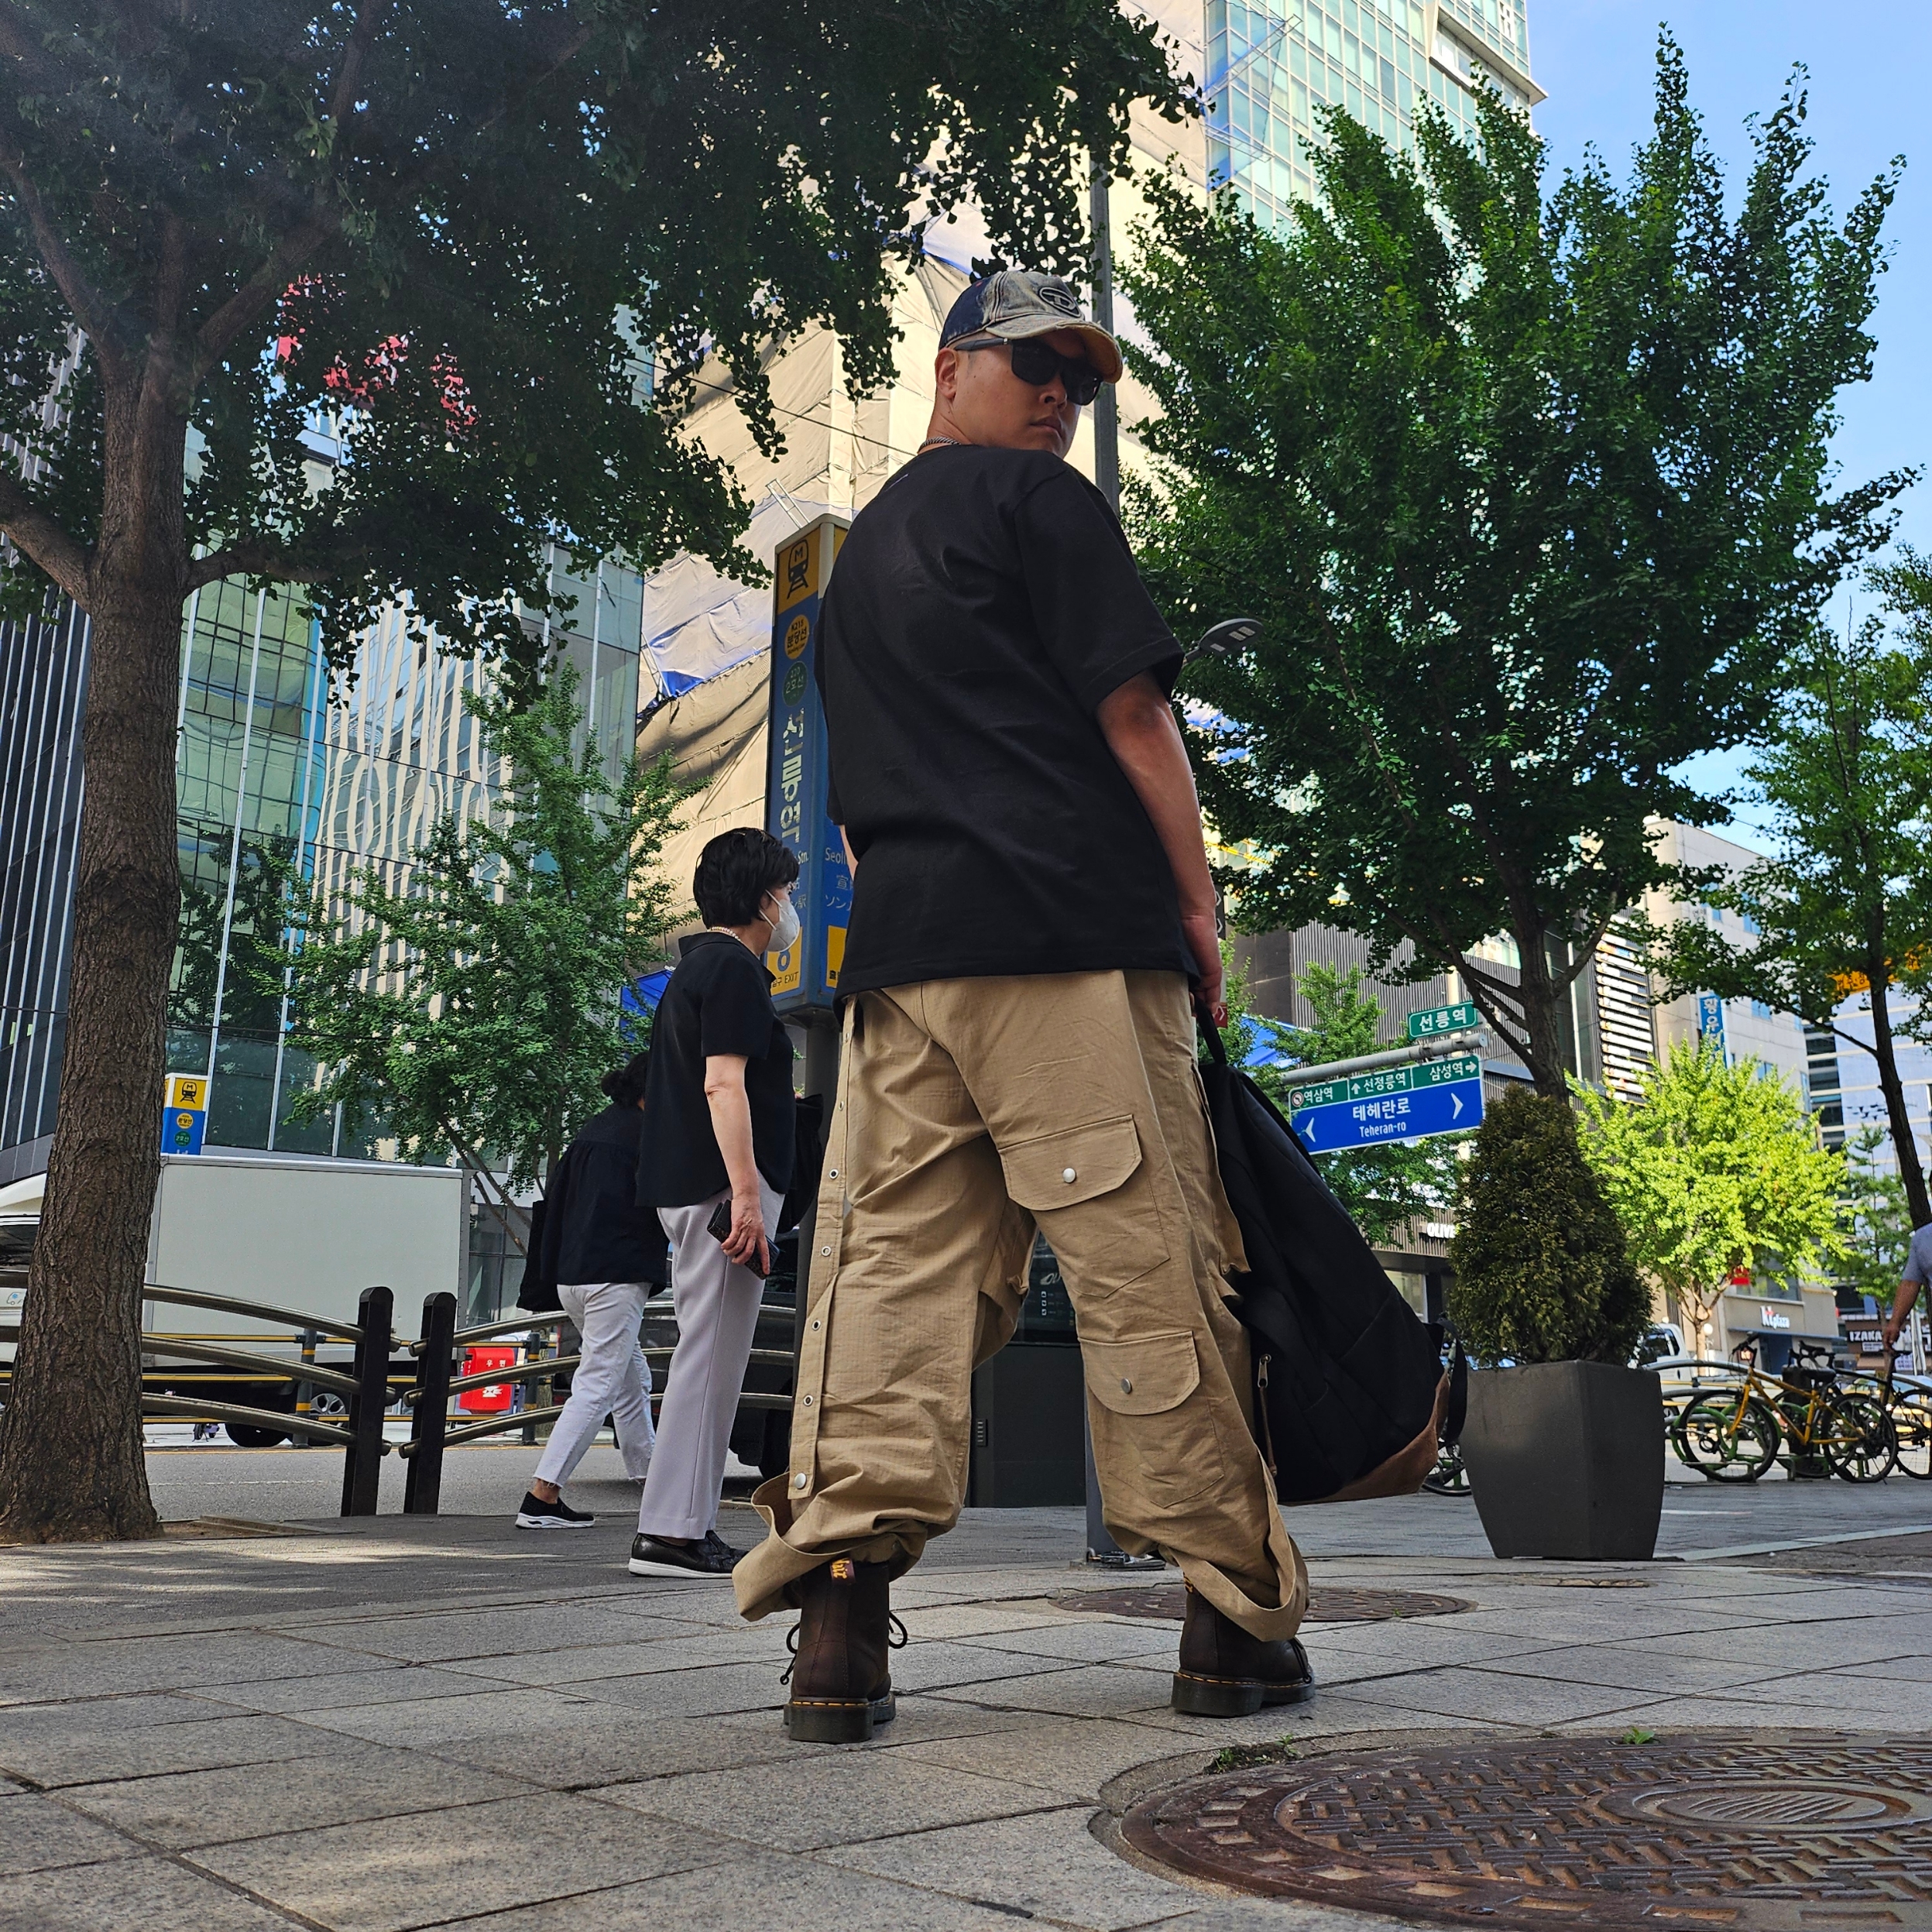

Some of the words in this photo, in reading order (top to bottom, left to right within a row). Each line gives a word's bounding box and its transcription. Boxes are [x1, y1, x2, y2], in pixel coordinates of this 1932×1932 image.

[787, 626, 807, 649] 분당선
[785, 675, 804, 695] 2호선
[781, 707, 805, 844] 선릉역
[825, 847, 846, 865] Seoll
[836, 874, 853, 891] 宣
[784, 971, 799, 983] EXIT
[1419, 1006, 1467, 1033] 선릉역
[1429, 1061, 1464, 1081] 삼성역
[1363, 1072, 1406, 1093] 선정릉역
[1303, 1086, 1333, 1104] 역삼역
[1352, 1097, 1411, 1121] 테헤란로
[1359, 1121, 1407, 1138] Teheran-ro
[1849, 1330, 1882, 1342] IZAKA
